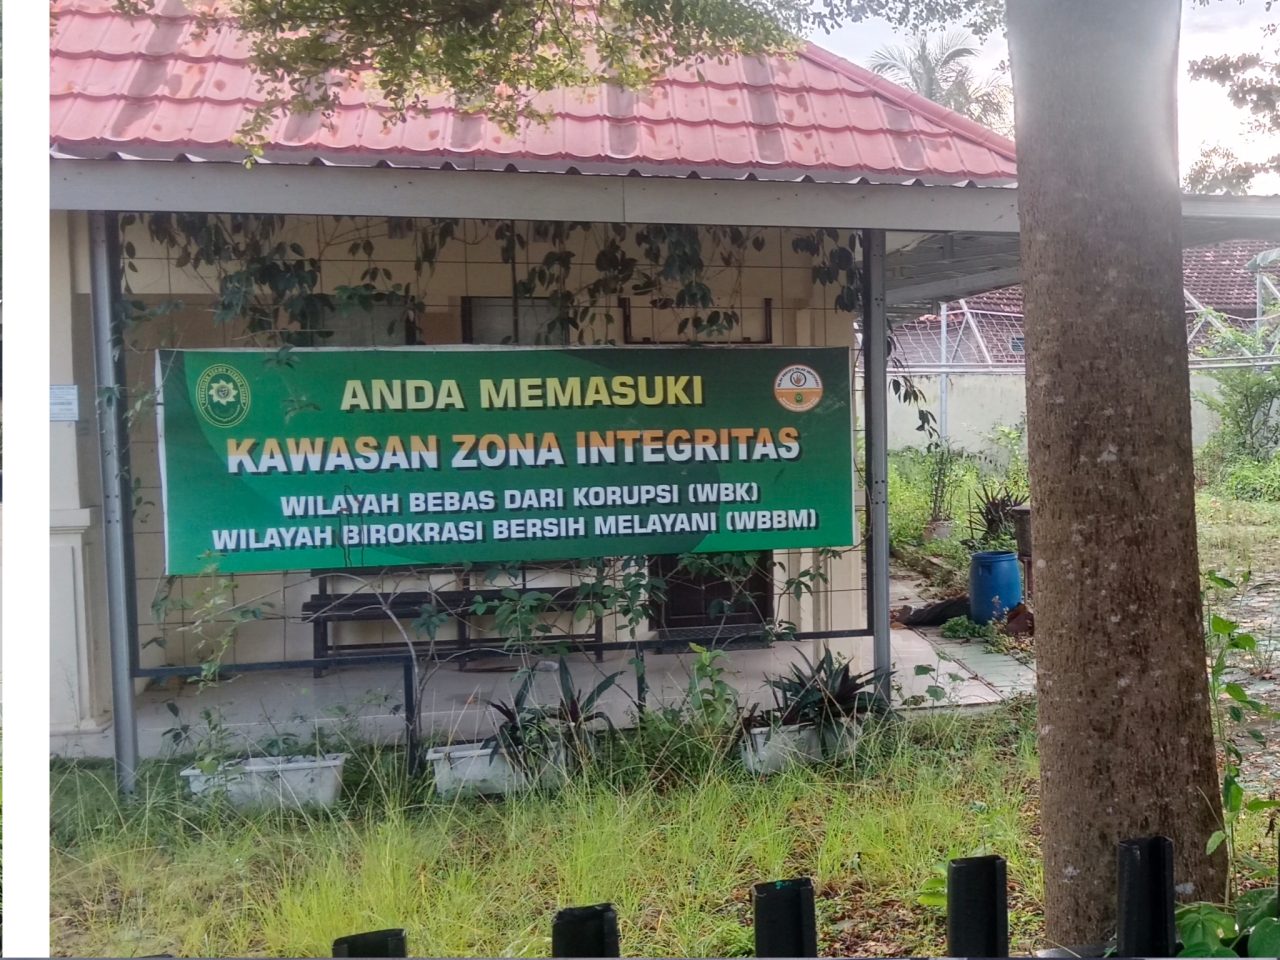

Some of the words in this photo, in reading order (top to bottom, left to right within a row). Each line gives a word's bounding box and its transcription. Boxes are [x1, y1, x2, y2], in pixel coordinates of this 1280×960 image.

[339, 378, 465, 410] ANDA
[479, 375, 704, 409] MEMASUKI
[226, 434, 440, 474] KAWASAN
[451, 432, 566, 469] ZONA
[576, 426, 801, 465] INTEGRITAS
[280, 493, 400, 517] WILAYAH
[409, 490, 496, 513] BEBAS
[503, 487, 564, 510] DARI
[573, 484, 679, 507] KORUPSI
[688, 481, 759, 503] (WBK)
[211, 525, 333, 551] WILAYAH
[342, 520, 484, 545] BIROKRASI
[492, 516, 585, 540] BERSIH
[593, 512, 717, 536] MELAYANI
[726, 508, 817, 531] (WBBM)
